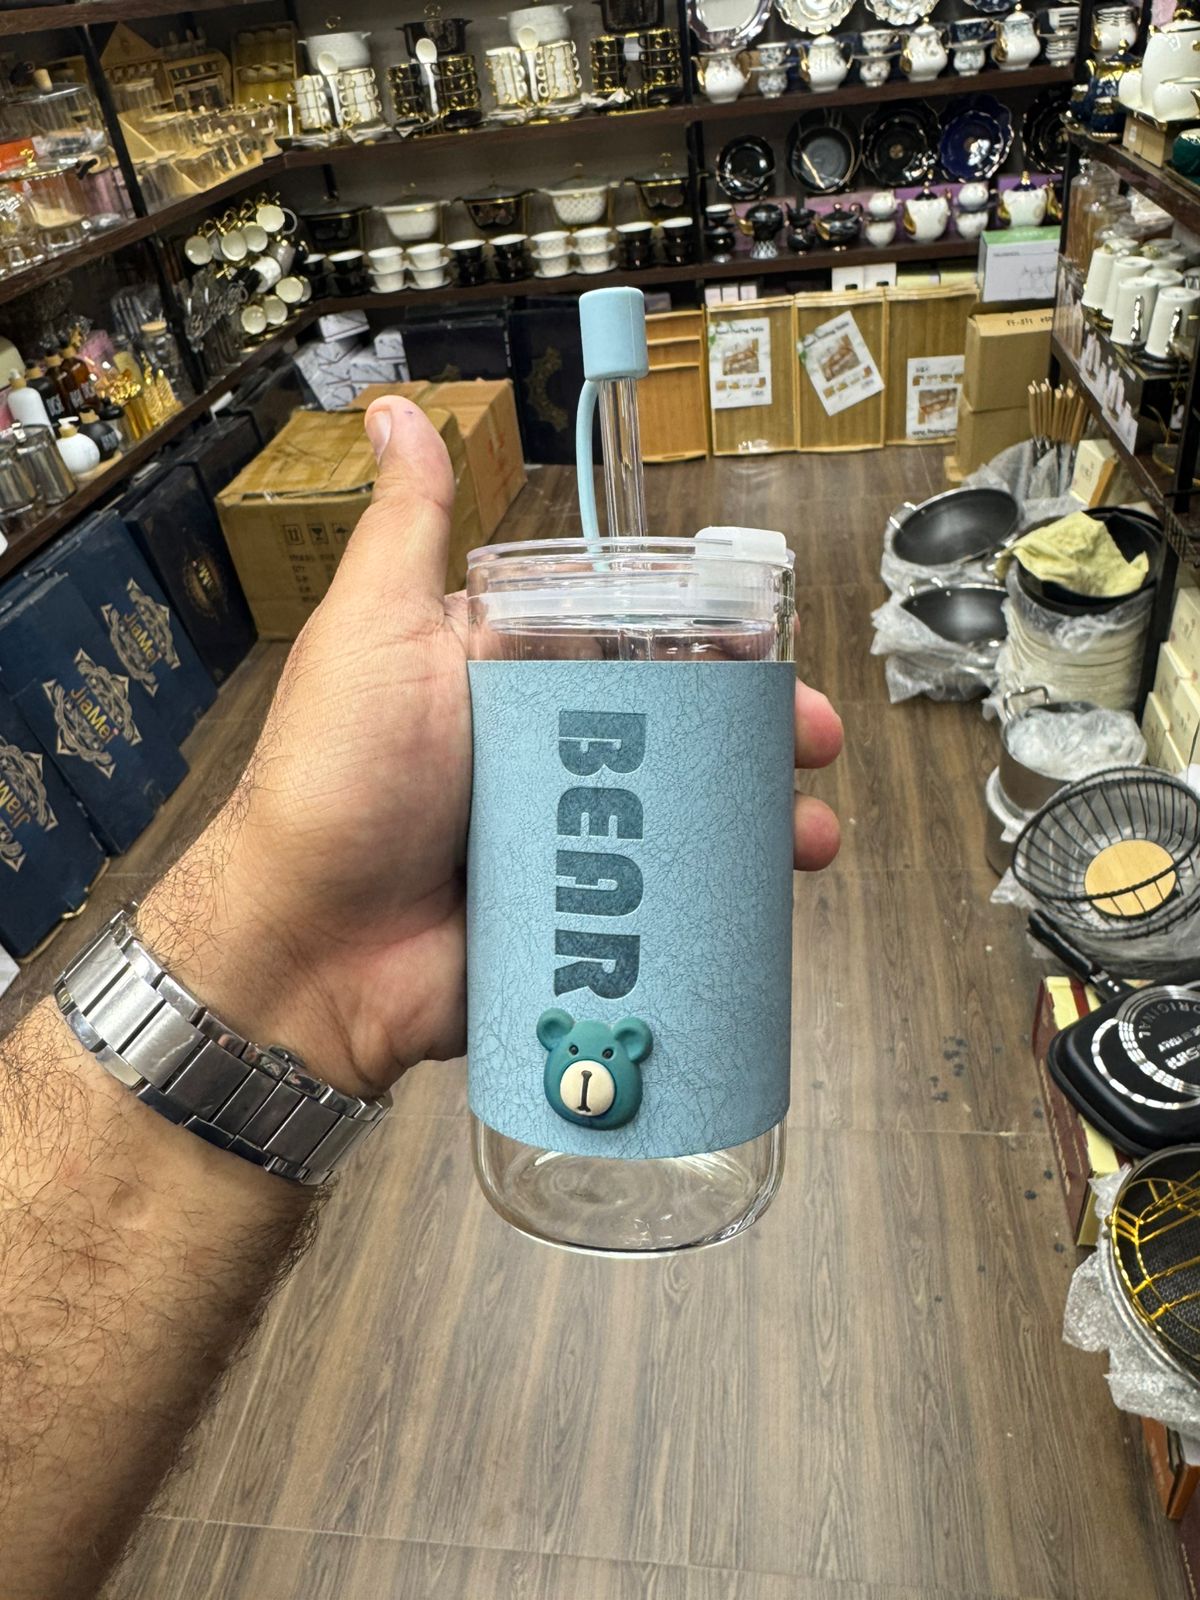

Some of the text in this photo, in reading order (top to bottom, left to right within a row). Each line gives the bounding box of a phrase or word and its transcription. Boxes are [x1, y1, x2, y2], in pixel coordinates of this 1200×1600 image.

[124, 609, 162, 666] JiaMei
[70, 685, 120, 745] JiaMei
[553, 708, 648, 1001] BEAR
[1157, 1035, 1184, 1053] ITALY
